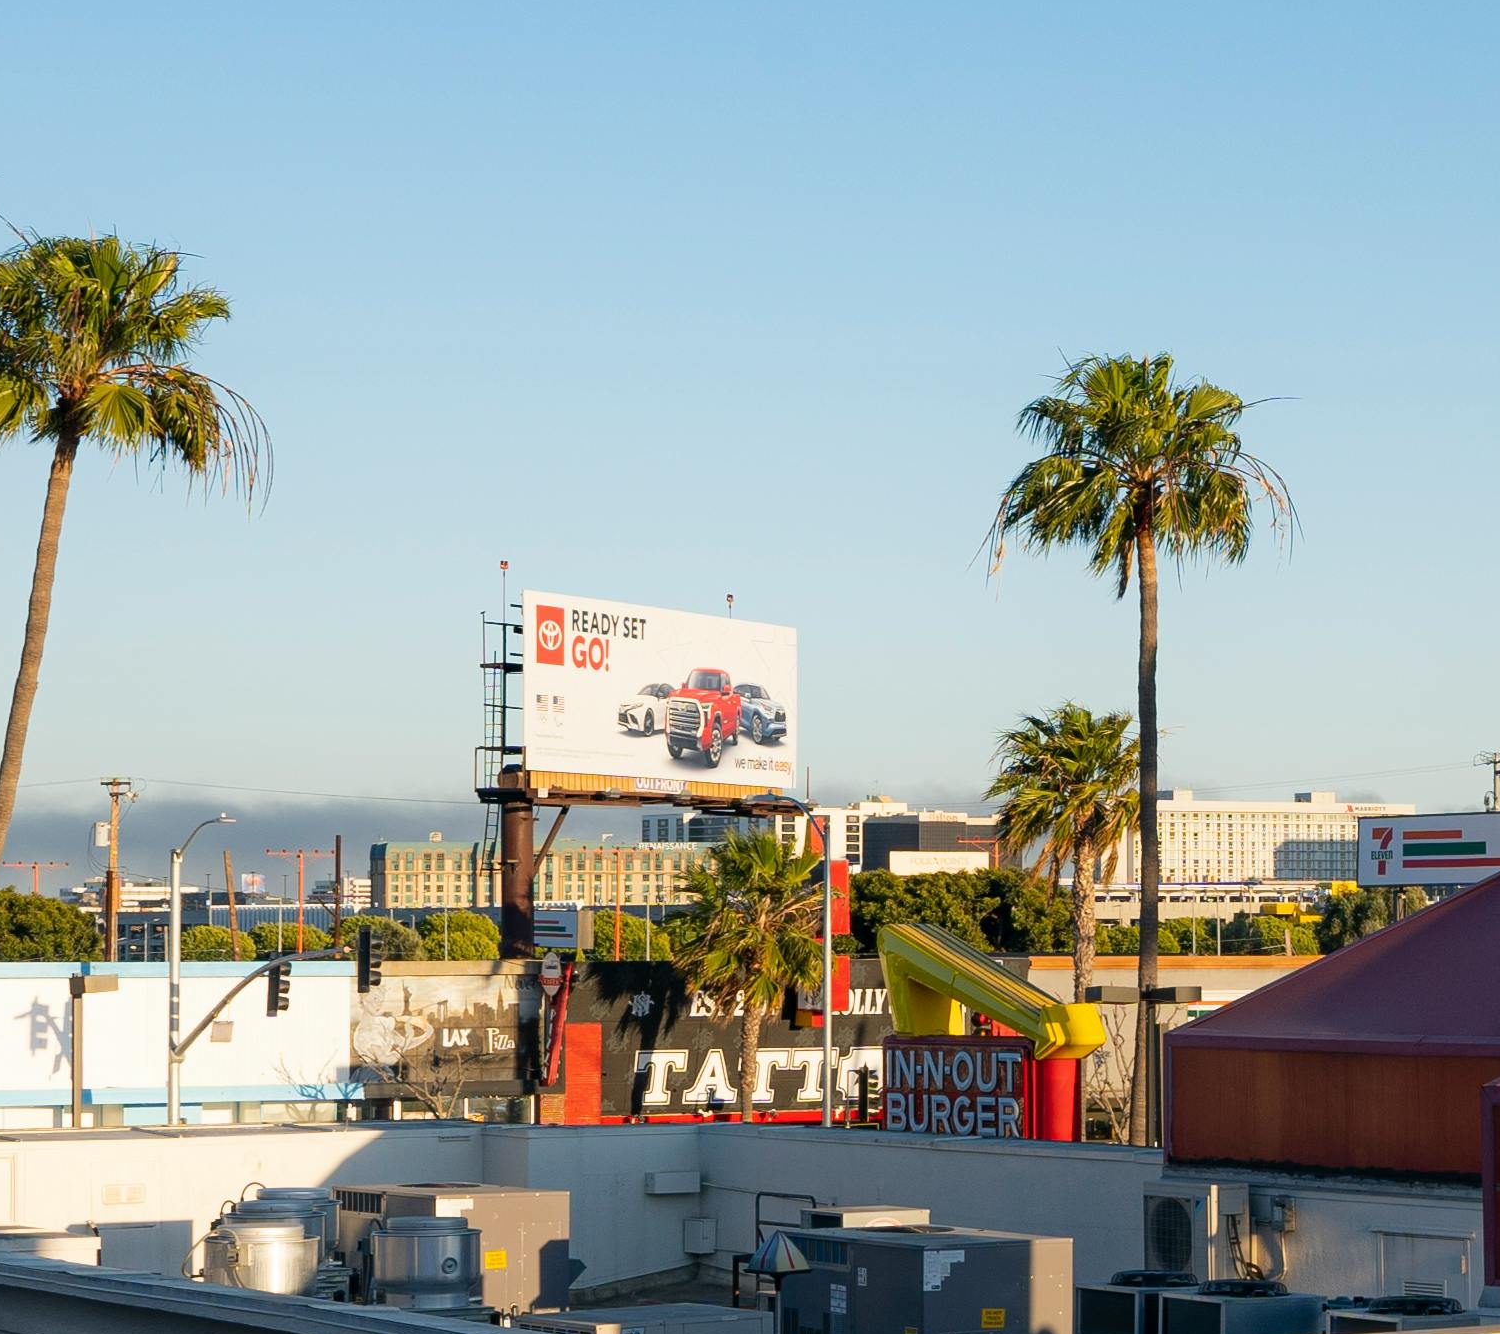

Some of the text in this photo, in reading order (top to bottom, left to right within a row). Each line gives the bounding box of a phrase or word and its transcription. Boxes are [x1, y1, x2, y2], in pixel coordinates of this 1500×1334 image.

[572, 609, 646, 640] READY SET
[572, 635, 610, 672] GO!
[735, 758, 746, 769] we
[748, 756, 767, 771] make
[769, 758, 774, 771] it
[636, 777, 686, 794] OUTFRONT
[639, 842, 697, 851] RENAISSANCE
[442, 1028, 516, 1053] LAX Pizza
[886, 1049, 1022, 1094] IN-N-OUT
[886, 1092, 1022, 1140] BURGER
